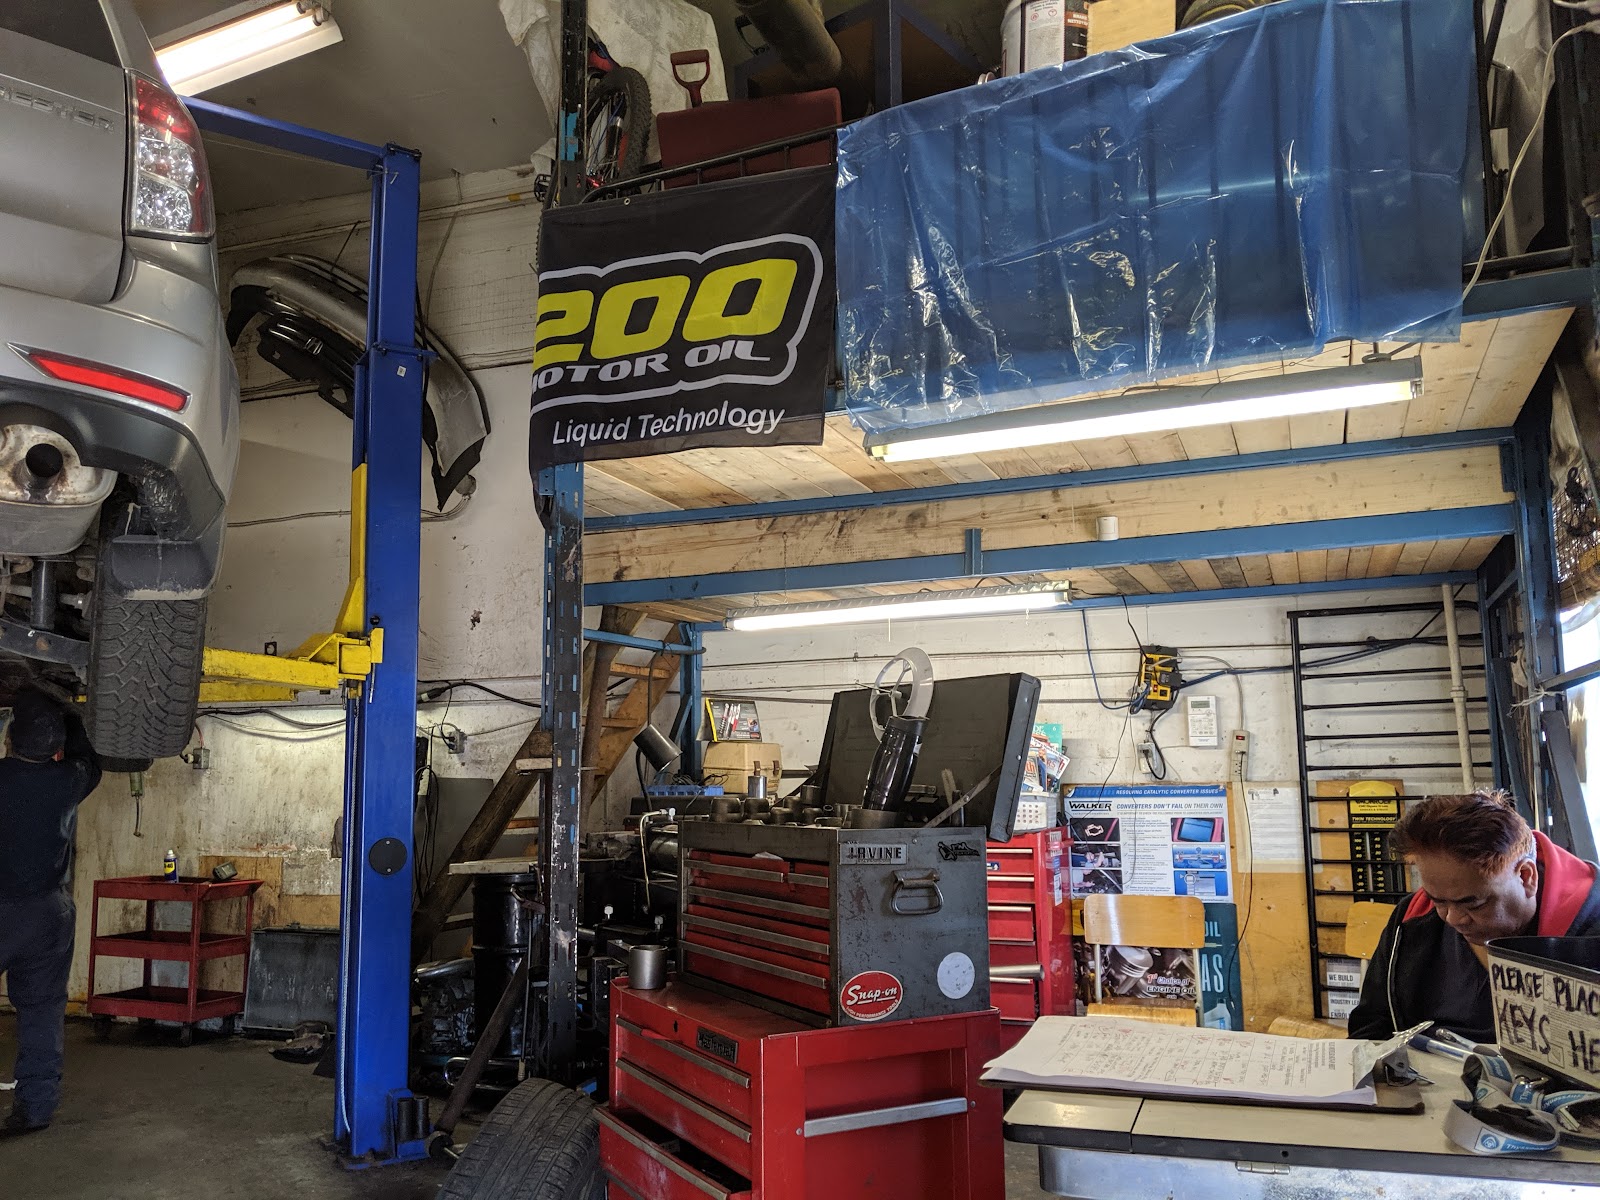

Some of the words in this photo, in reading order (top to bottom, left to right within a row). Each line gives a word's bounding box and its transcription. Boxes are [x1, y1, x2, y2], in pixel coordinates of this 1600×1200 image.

[533, 258, 798, 373] 200
[685, 340, 770, 368] OIL
[553, 416, 631, 447] Liquid
[638, 400, 786, 438] Technology
[1069, 801, 1112, 811] WALKER
[1157, 976, 1182, 985] Choice
[1491, 963, 1543, 998] PLEASE
[1553, 975, 1600, 1016] PLAC
[846, 984, 898, 1006] Snap-on
[856, 1010, 887, 1018] PERFORMANCE
[1495, 996, 1551, 1054] KEYS
[1568, 1030, 1600, 1074] HE
